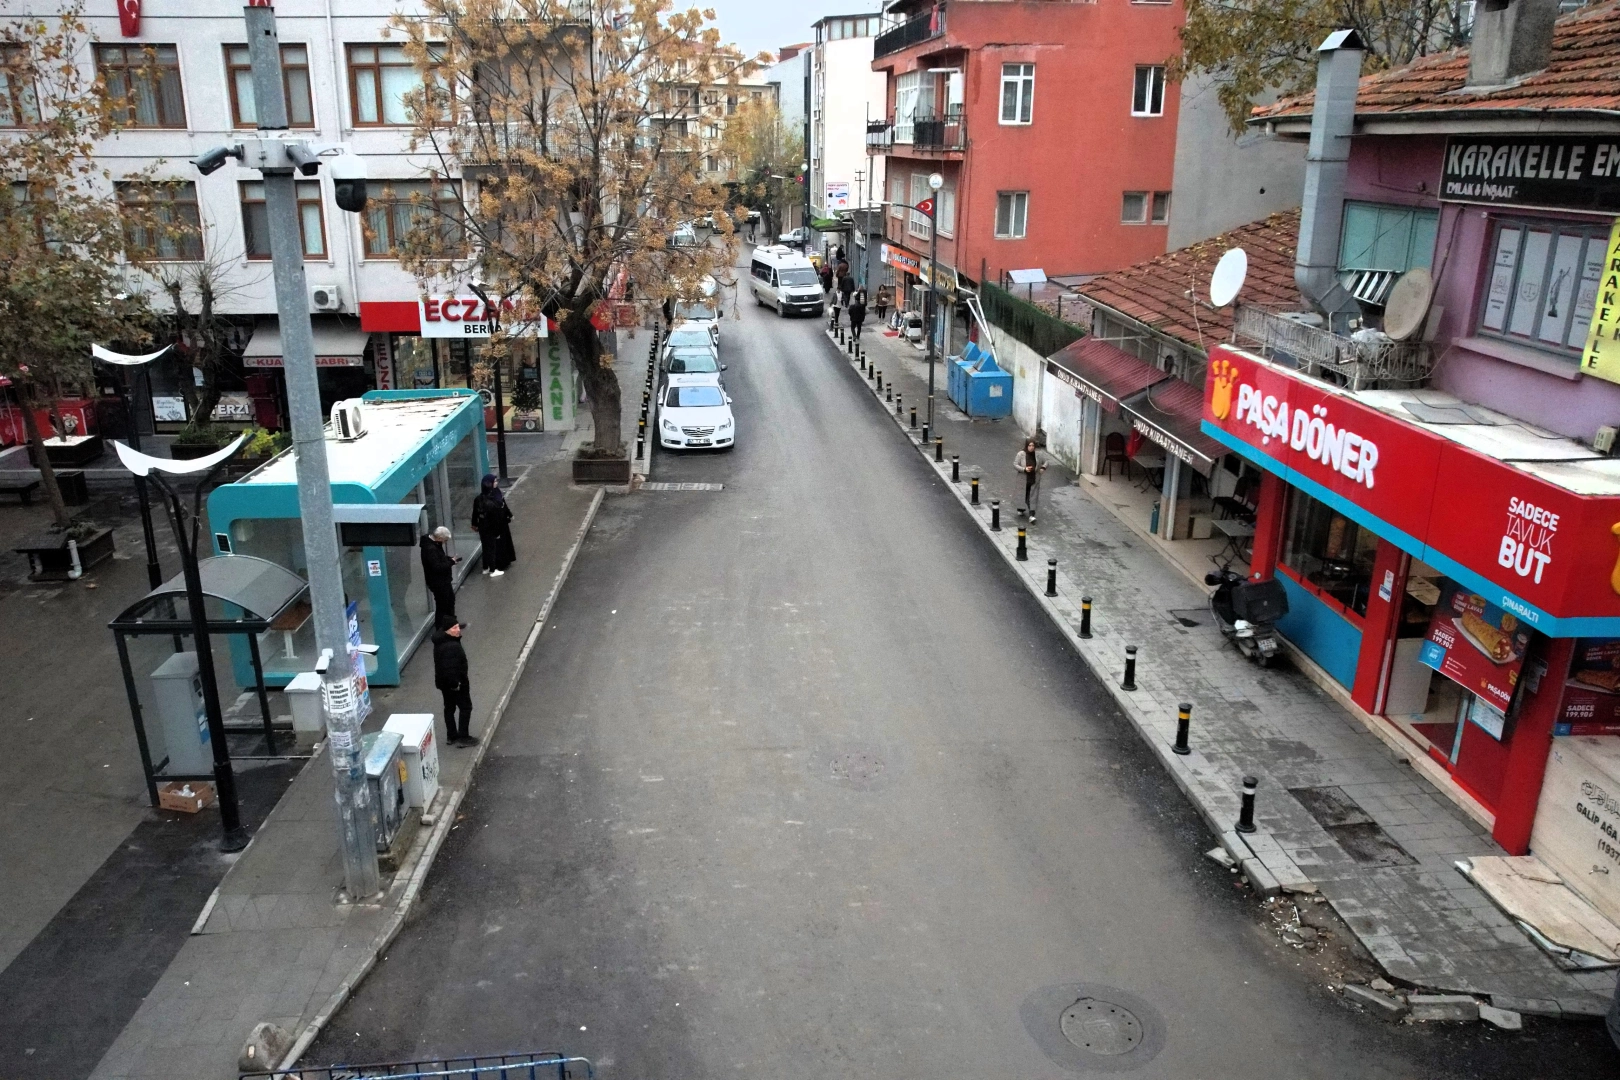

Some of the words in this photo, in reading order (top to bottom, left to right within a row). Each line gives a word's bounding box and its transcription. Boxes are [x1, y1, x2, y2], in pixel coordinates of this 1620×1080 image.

[1447, 144, 1585, 180] KARAKELLE
[1236, 383, 1289, 445] PAŞA
[1290, 404, 1379, 489] DÖNER
[1508, 496, 1560, 532] SADECE
[1506, 512, 1555, 555] TAVUK
[1498, 535, 1551, 584] BUT
[1502, 596, 1539, 623] ÇINARALTI
[1434, 629, 1455, 644] SADECE
[1567, 704, 1595, 712] SADECE
[1576, 802, 1600, 824] GALİP
[1600, 821, 1617, 840] AĞA
